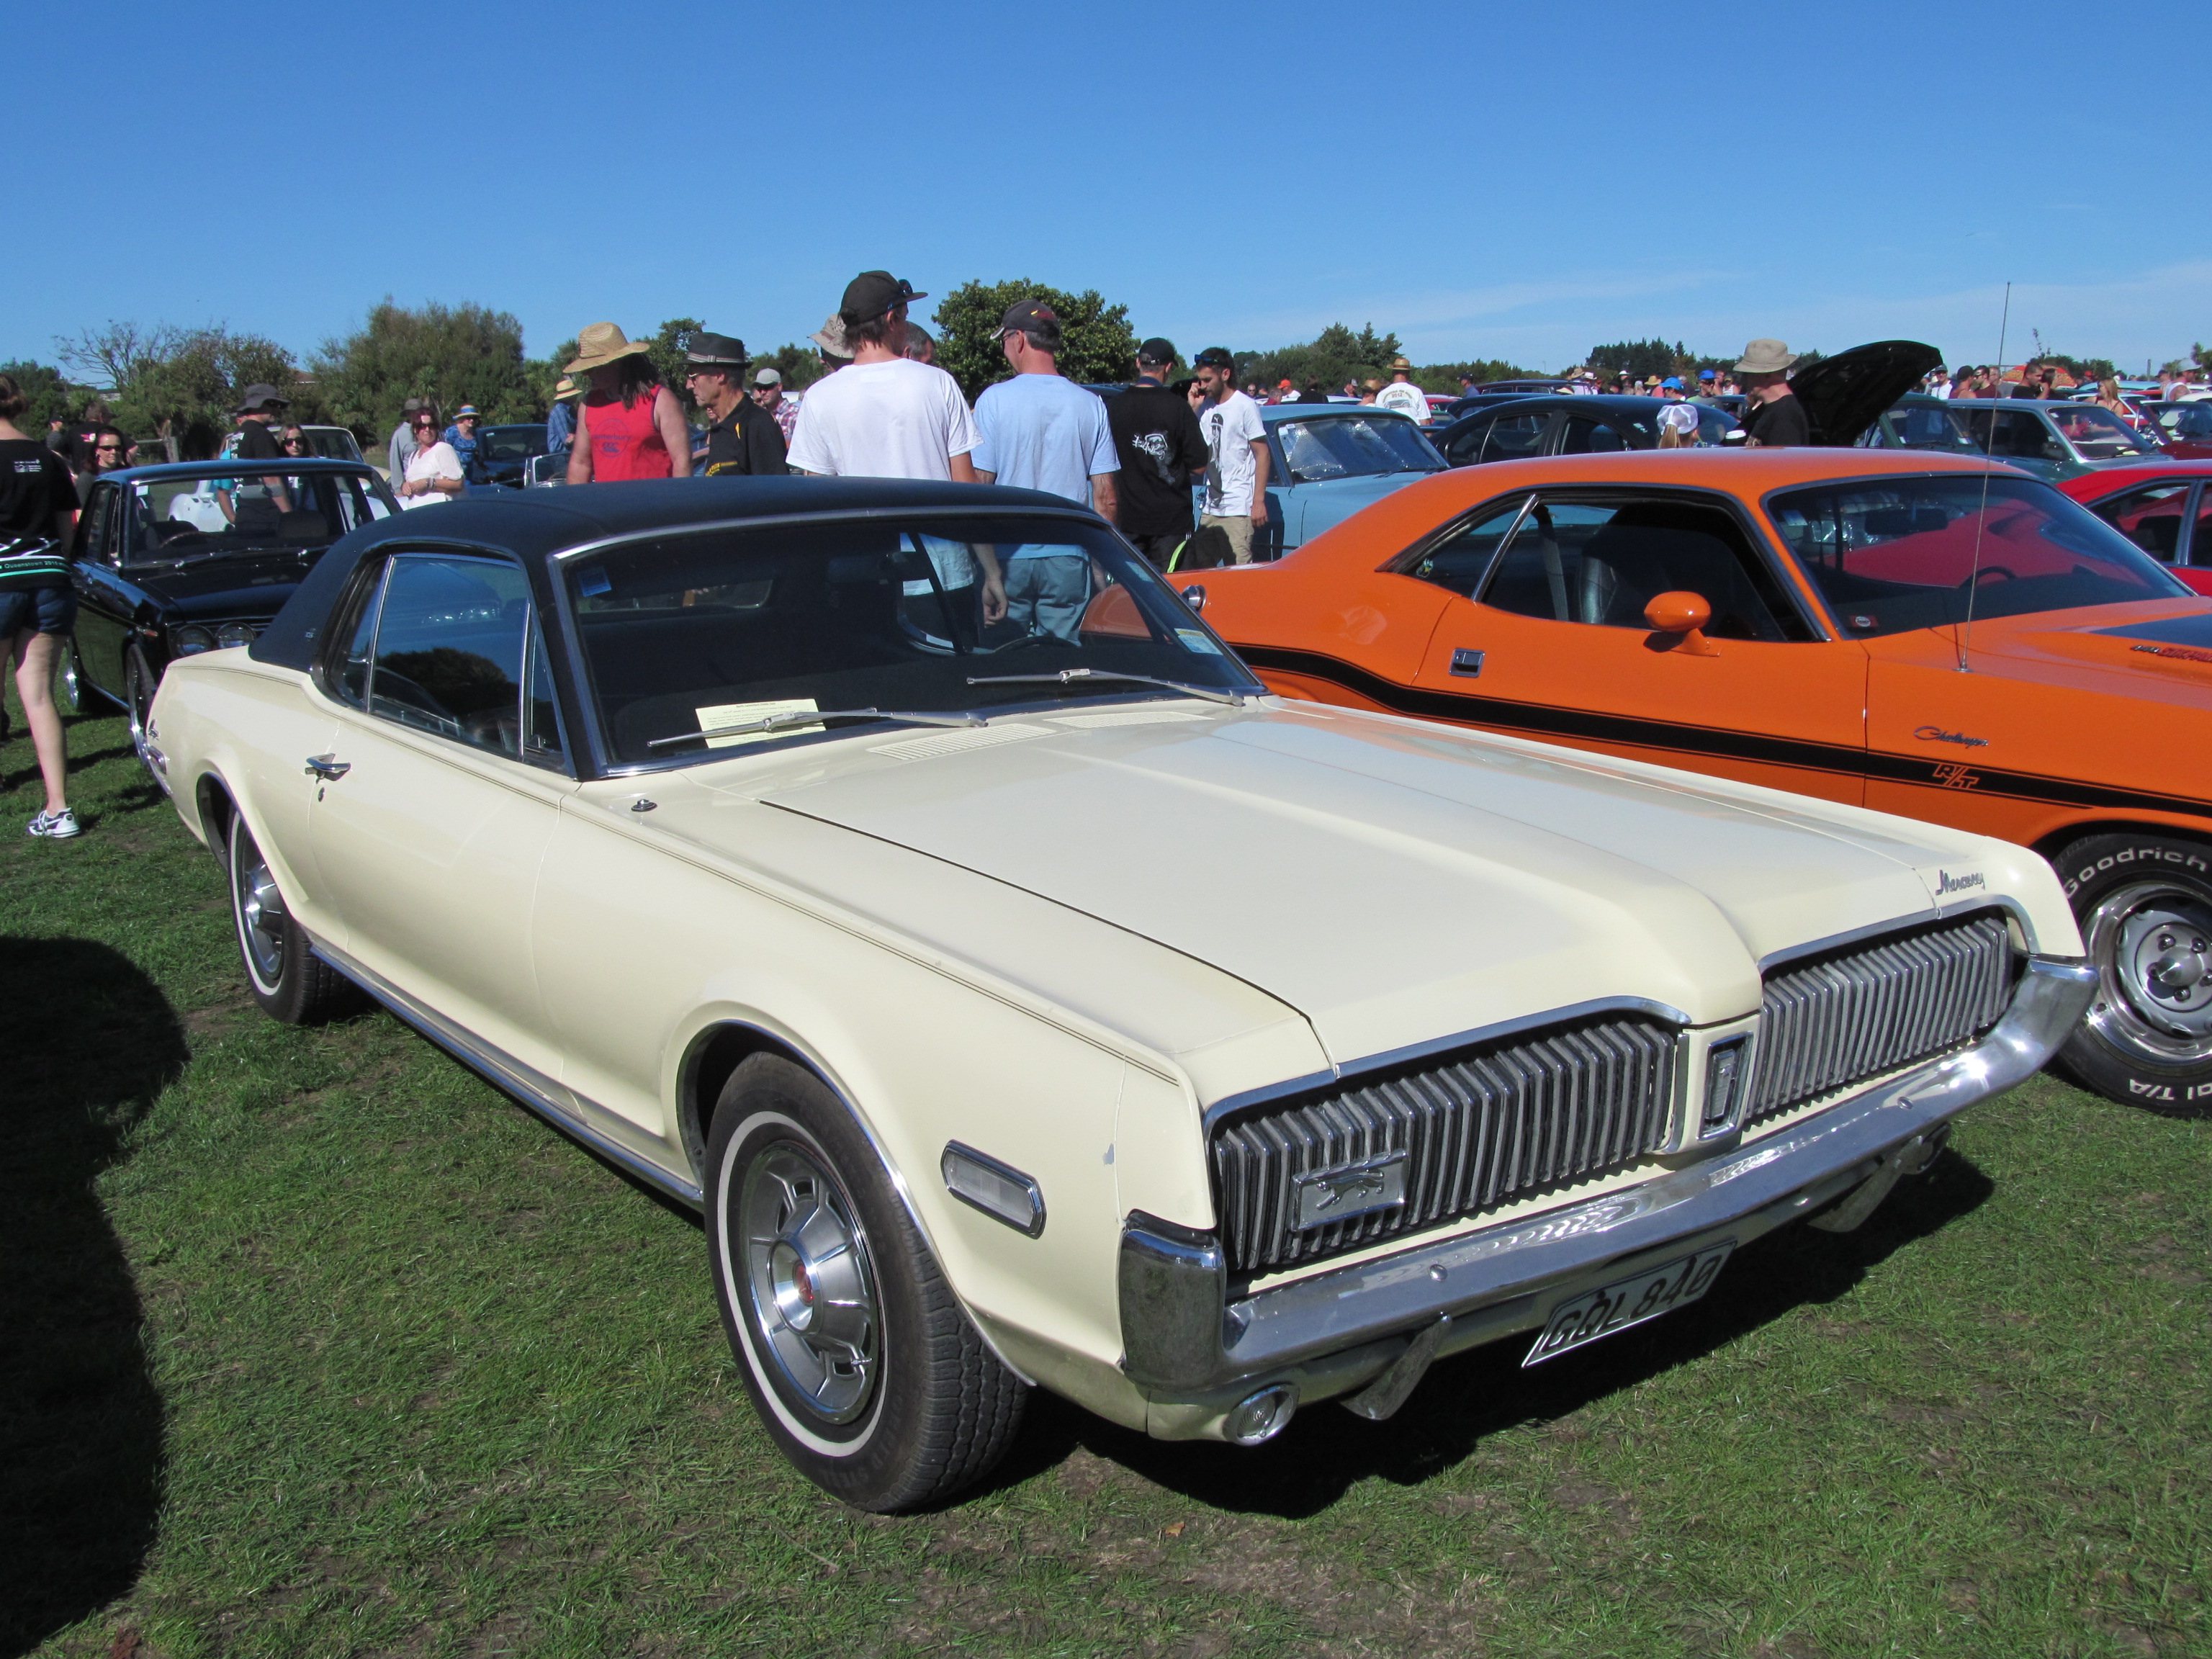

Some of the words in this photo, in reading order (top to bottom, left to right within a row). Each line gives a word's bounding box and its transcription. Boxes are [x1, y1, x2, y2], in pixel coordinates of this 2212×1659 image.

[1932, 763, 1981, 789] R/T
[1935, 869, 1986, 896] Mercury
[1629, 1253, 1724, 1320] 840
